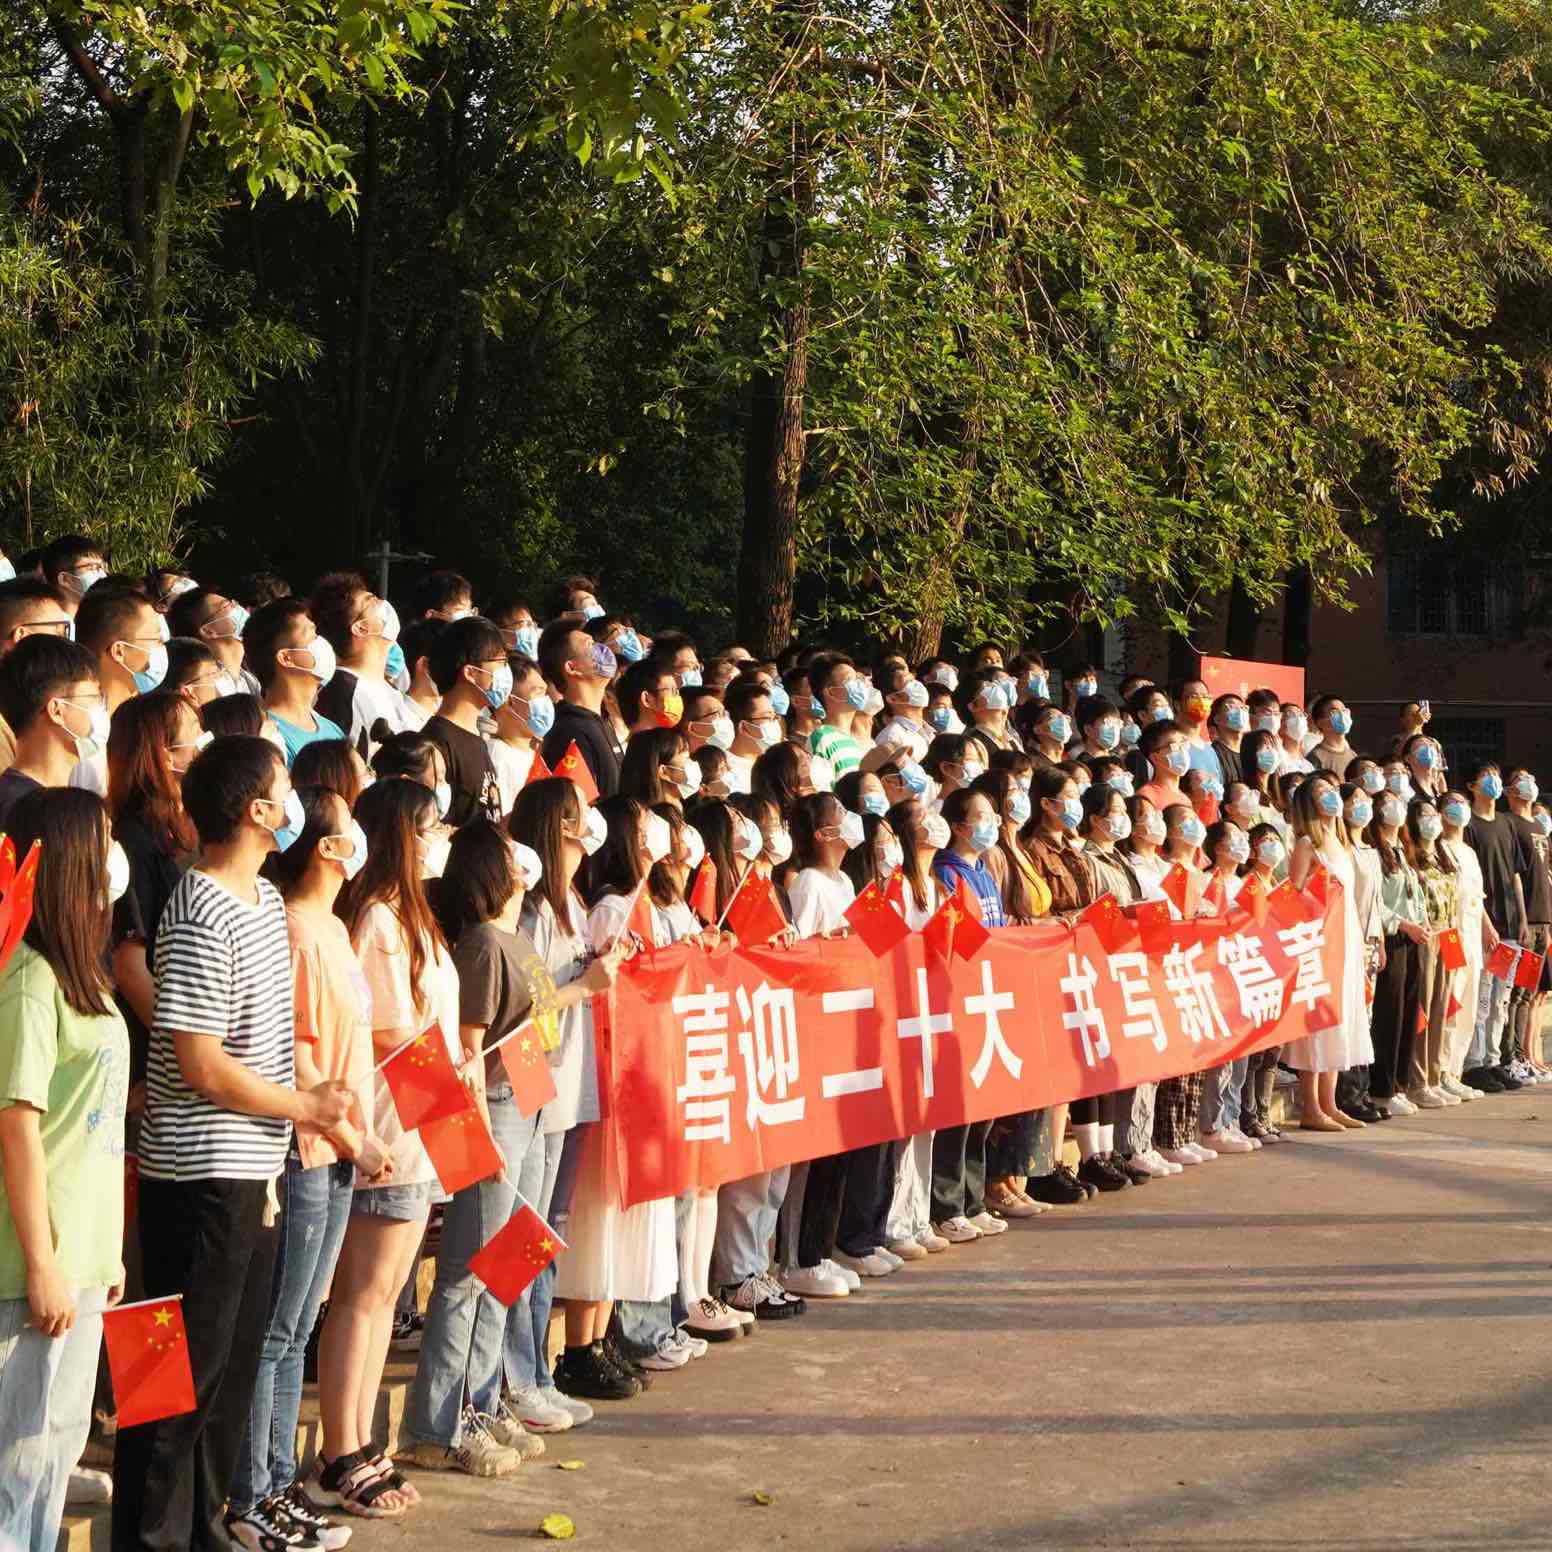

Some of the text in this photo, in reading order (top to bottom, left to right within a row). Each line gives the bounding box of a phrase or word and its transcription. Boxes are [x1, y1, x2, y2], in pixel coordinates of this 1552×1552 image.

[672, 918, 1332, 1145] 喜迎二十大 书写新篇章
